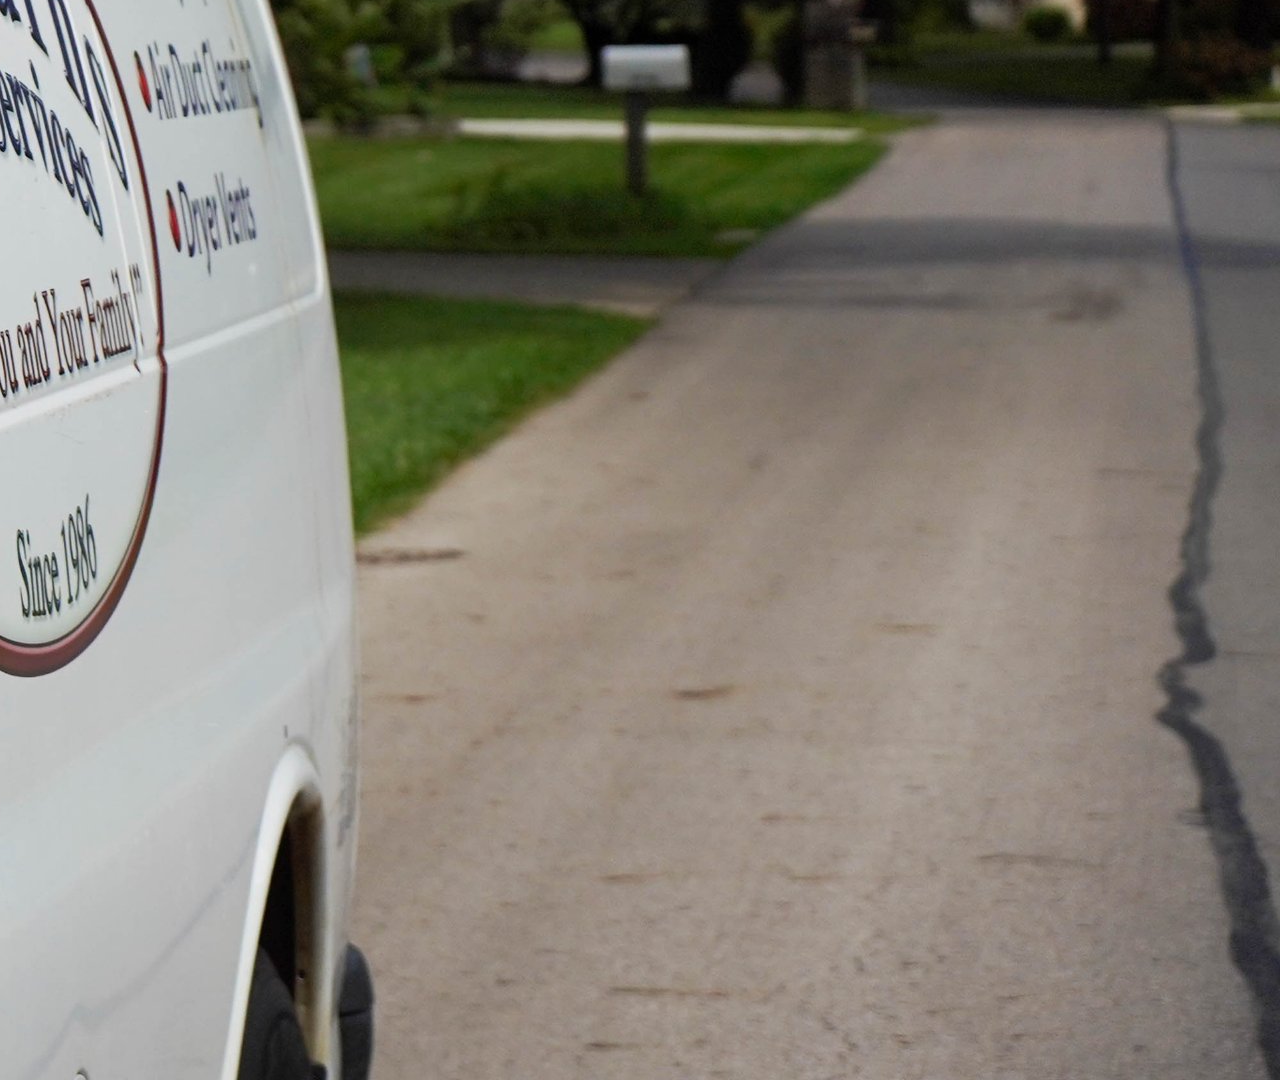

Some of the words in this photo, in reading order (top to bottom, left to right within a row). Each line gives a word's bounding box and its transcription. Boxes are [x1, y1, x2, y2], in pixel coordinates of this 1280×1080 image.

[147, 40, 178, 120] Air
[167, 43, 212, 118] Duct
[177, 180, 223, 276] Dryer
[214, 171, 257, 246] Vents
[16, 291, 51, 389] and
[41, 288, 89, 377] Your
[16, 528, 62, 618] Since
[61, 492, 98, 605] 1986
